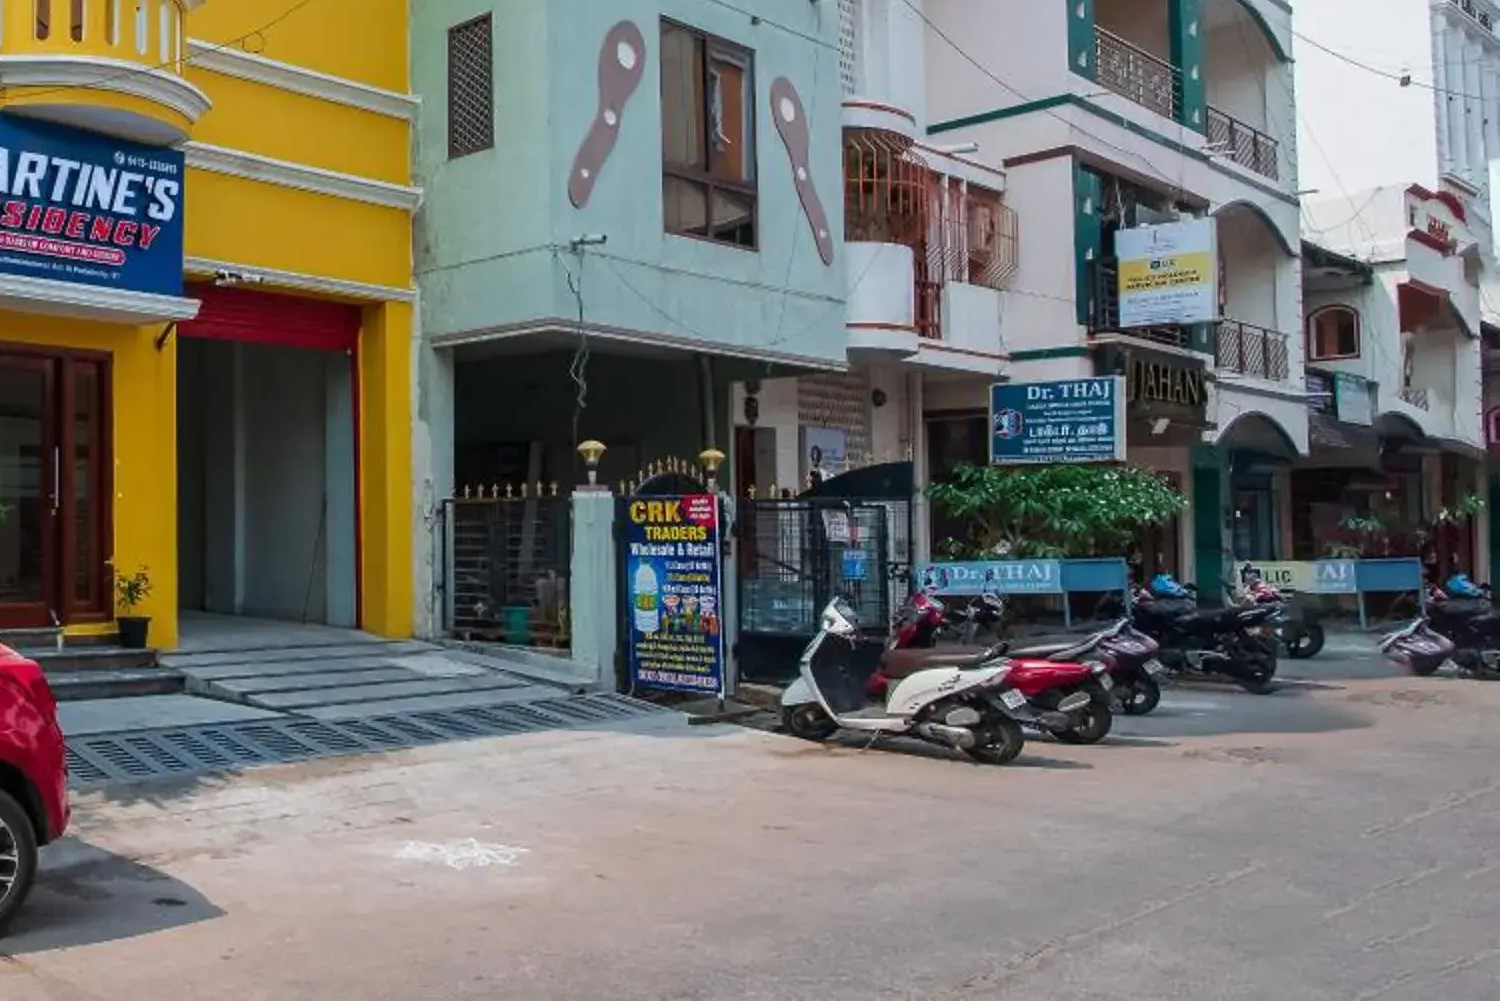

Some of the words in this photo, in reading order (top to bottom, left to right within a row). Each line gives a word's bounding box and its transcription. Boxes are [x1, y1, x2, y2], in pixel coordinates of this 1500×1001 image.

[1027, 386, 1054, 400] Dr.
[1058, 381, 1111, 400] THAJ
[629, 500, 682, 524] CRK
[644, 525, 708, 541] TRADERS
[992, 563, 1052, 582] THAJ
[1264, 569, 1292, 584] LIC
